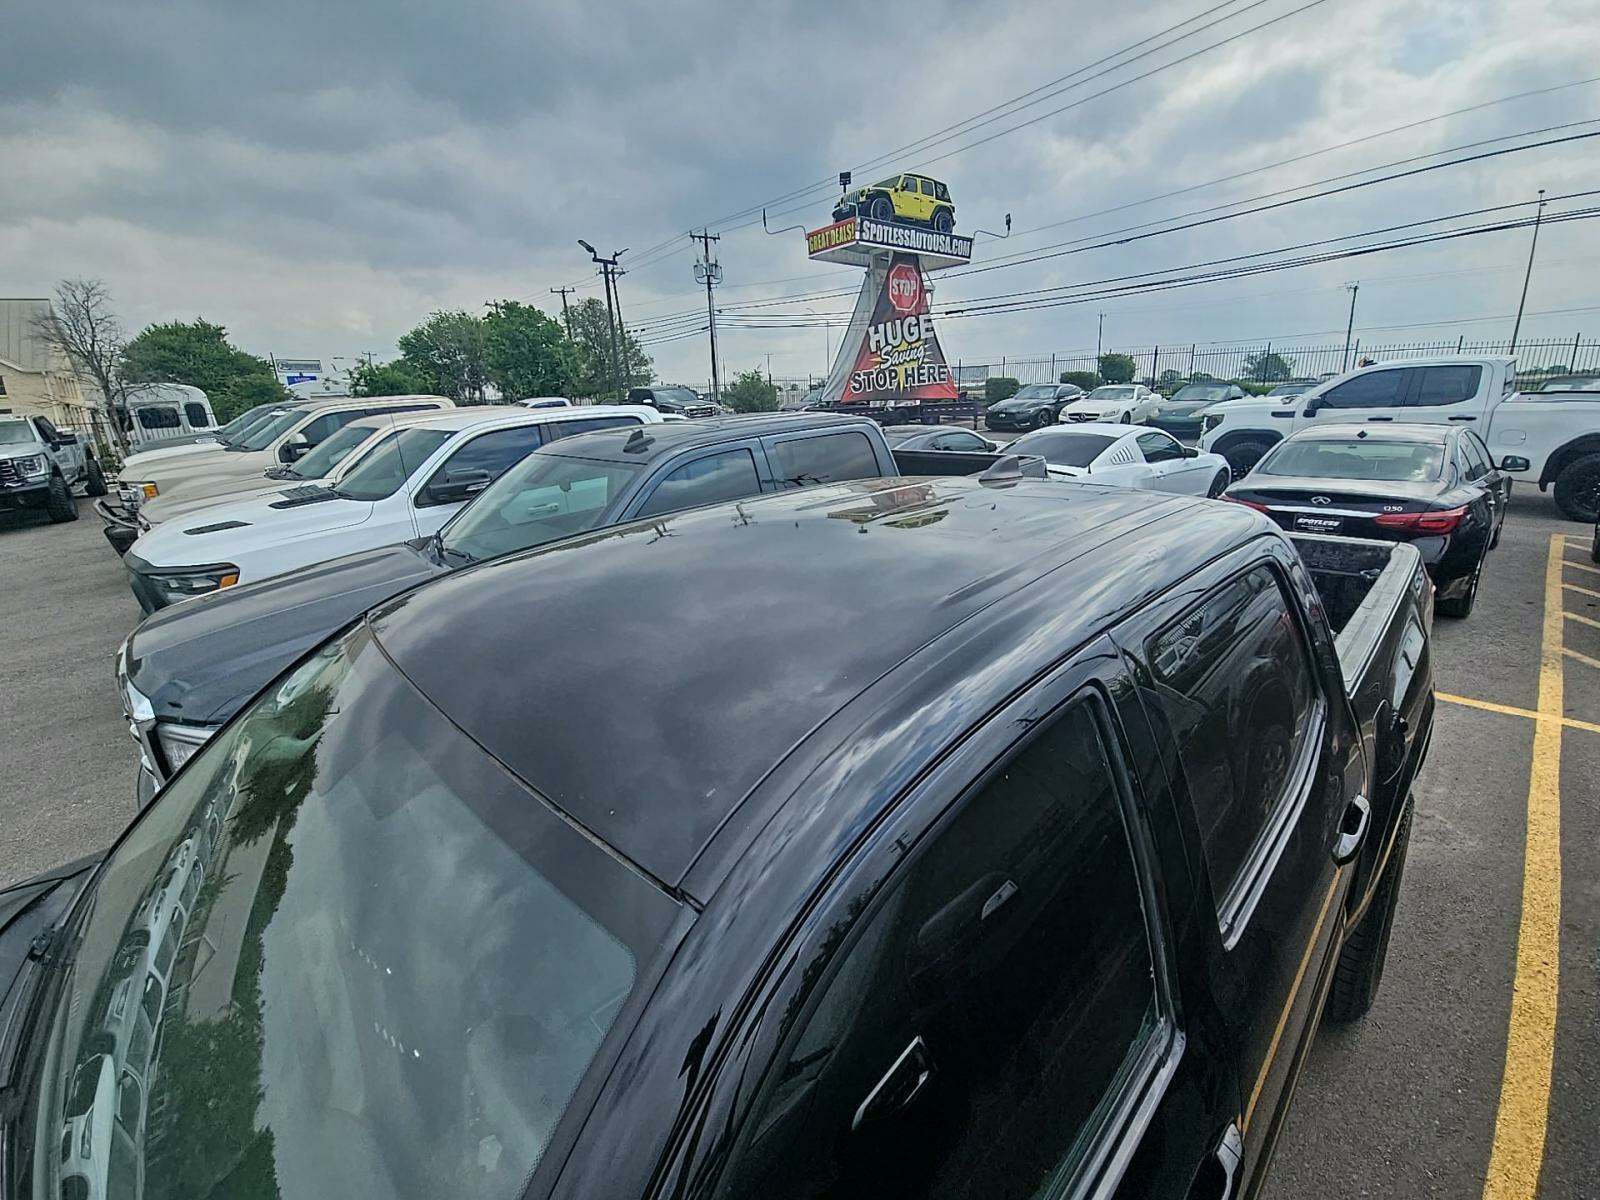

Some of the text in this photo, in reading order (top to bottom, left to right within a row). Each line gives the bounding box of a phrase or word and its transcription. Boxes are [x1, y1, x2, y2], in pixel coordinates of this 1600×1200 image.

[808, 222, 855, 253] GREAT DEALS!
[892, 278, 917, 297] STOP
[868, 315, 935, 353] HUGE
[879, 345, 925, 369] Saving
[850, 364, 949, 394] STOP HERE
[1297, 517, 1340, 527] SPOTLESS
